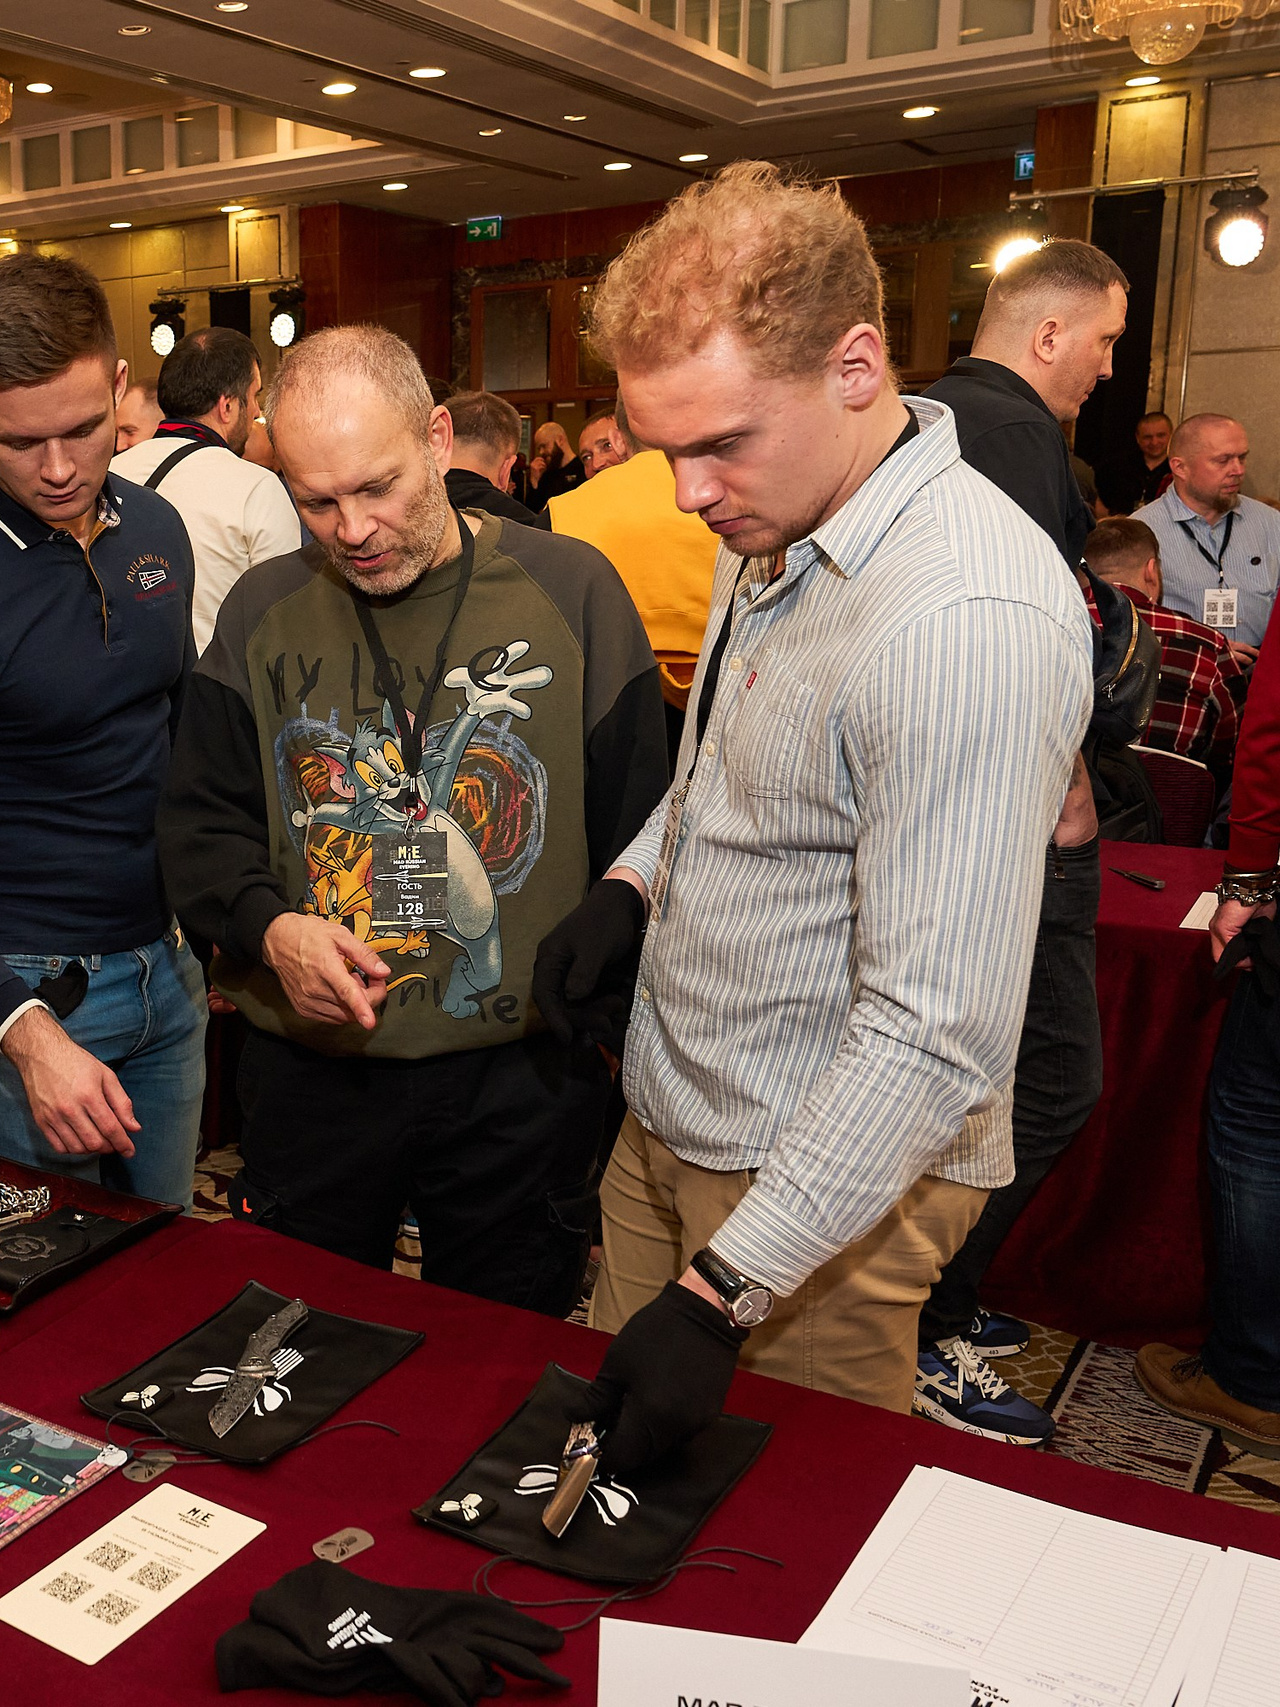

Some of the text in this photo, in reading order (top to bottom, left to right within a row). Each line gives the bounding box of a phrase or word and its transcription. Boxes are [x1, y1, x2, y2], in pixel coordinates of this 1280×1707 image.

[396, 902, 424, 915] 128
[327, 1622, 358, 1649] RUSSIAN
[983, 1691, 1010, 1703] MAD
